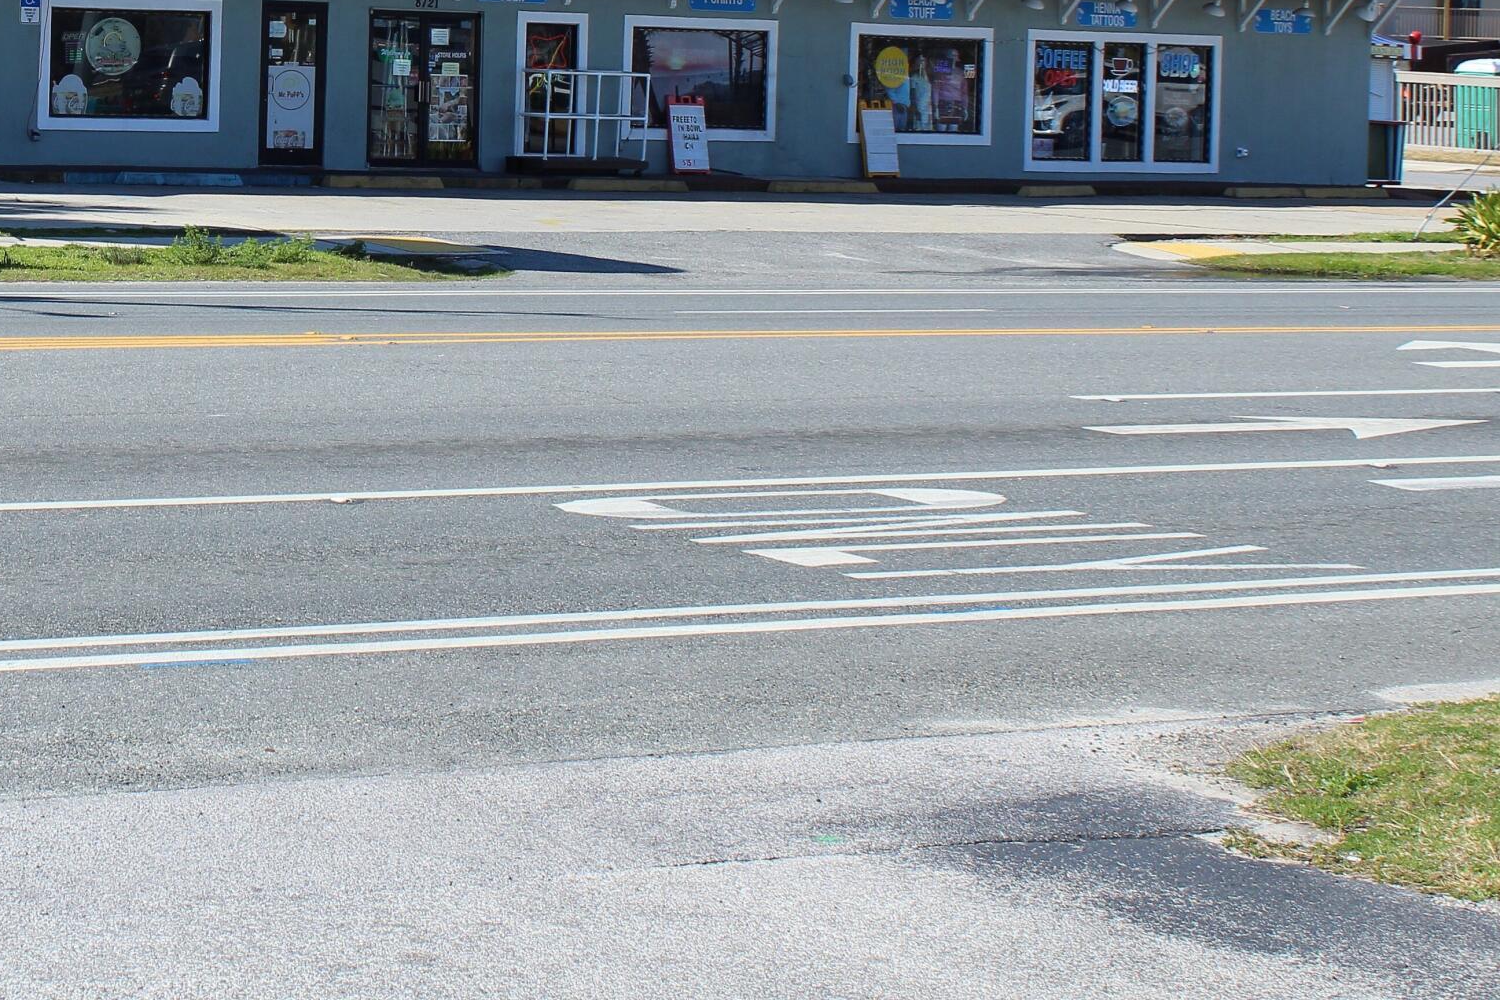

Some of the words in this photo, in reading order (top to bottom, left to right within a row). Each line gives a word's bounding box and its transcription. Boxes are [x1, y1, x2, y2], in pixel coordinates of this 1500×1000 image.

[908, 7, 936, 19] STUFF
[1270, 9, 1296, 21] BEACH
[1090, 14, 1125, 27] TATTOOS
[1273, 21, 1293, 33] TOYS
[1035, 48, 1088, 70] COFFEE
[686, 124, 703, 133] BOWL
